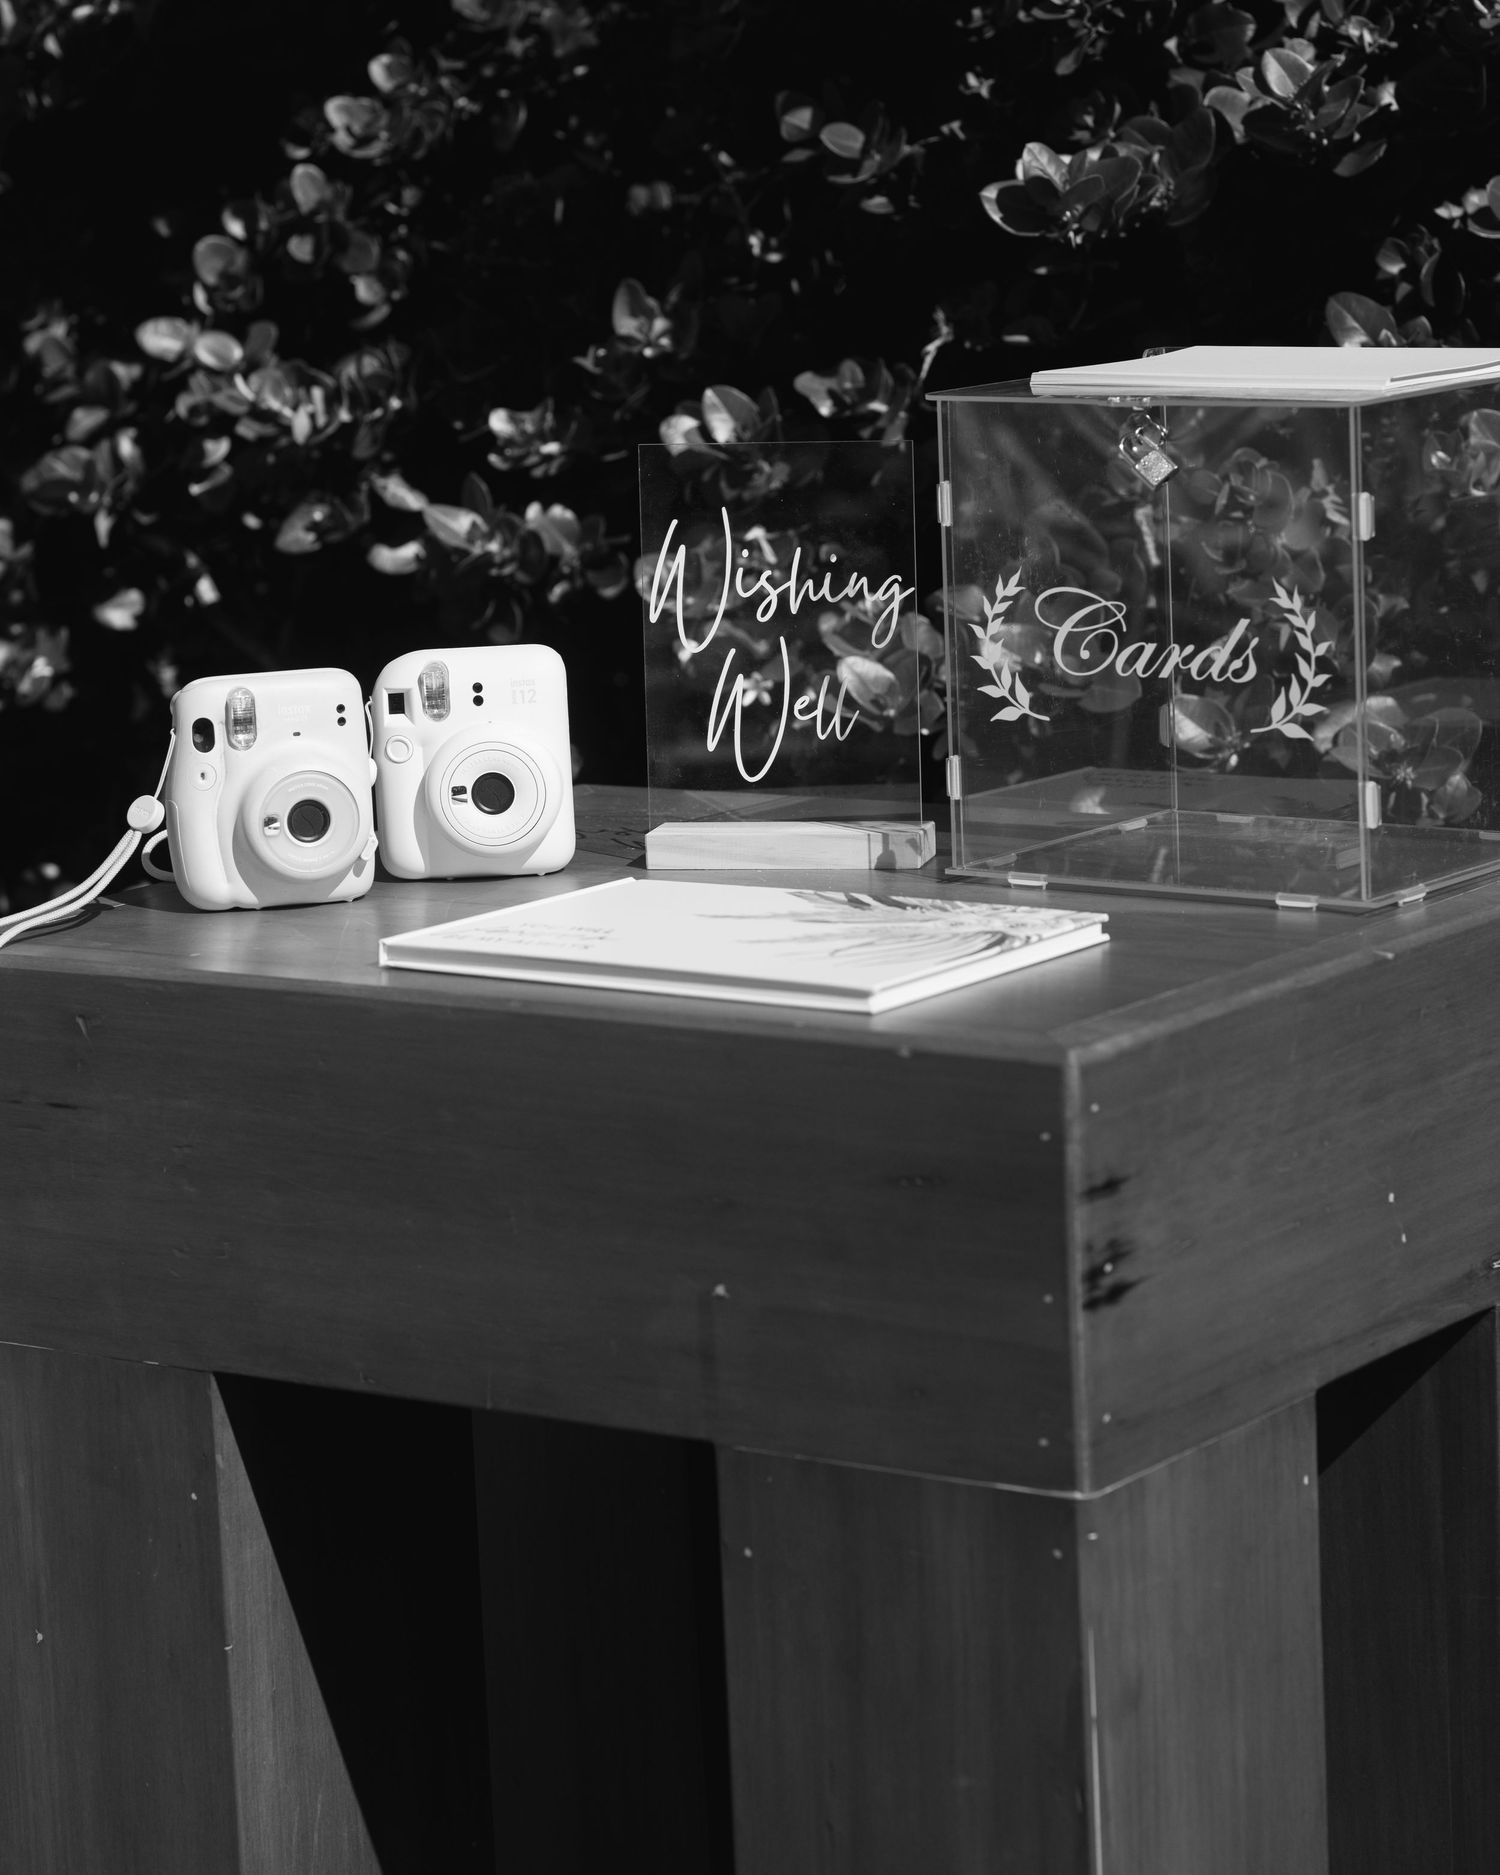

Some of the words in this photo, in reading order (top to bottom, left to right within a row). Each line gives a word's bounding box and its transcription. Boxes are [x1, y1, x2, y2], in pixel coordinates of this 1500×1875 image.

[649, 506, 915, 653] Wishing
[1034, 586, 1259, 683] Cards
[707, 636, 859, 783] Well
